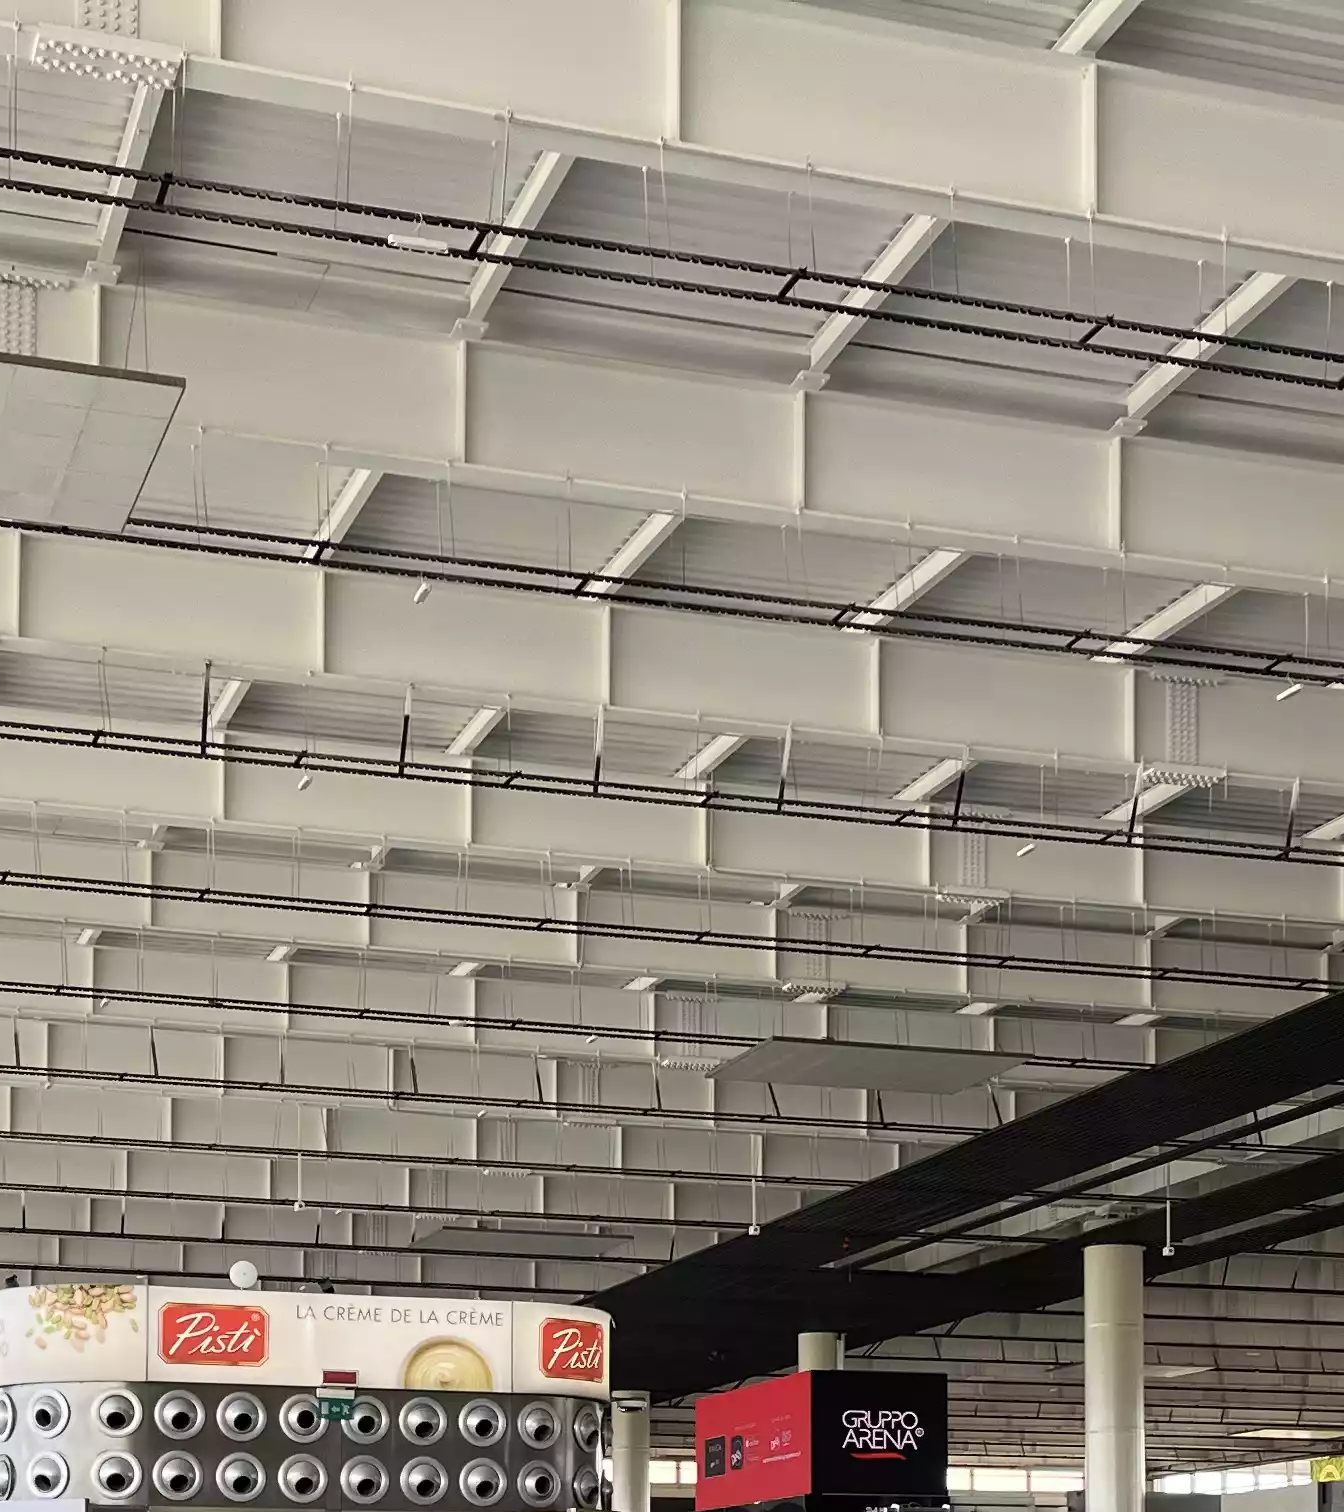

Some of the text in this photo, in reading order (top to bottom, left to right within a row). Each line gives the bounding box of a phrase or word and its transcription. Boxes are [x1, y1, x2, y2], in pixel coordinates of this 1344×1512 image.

[296, 1304, 504, 1328] LA CRÈME DE LA CRÈME
[841, 1409, 919, 1430] GRUPPO
[841, 1429, 918, 1450] ARENA
